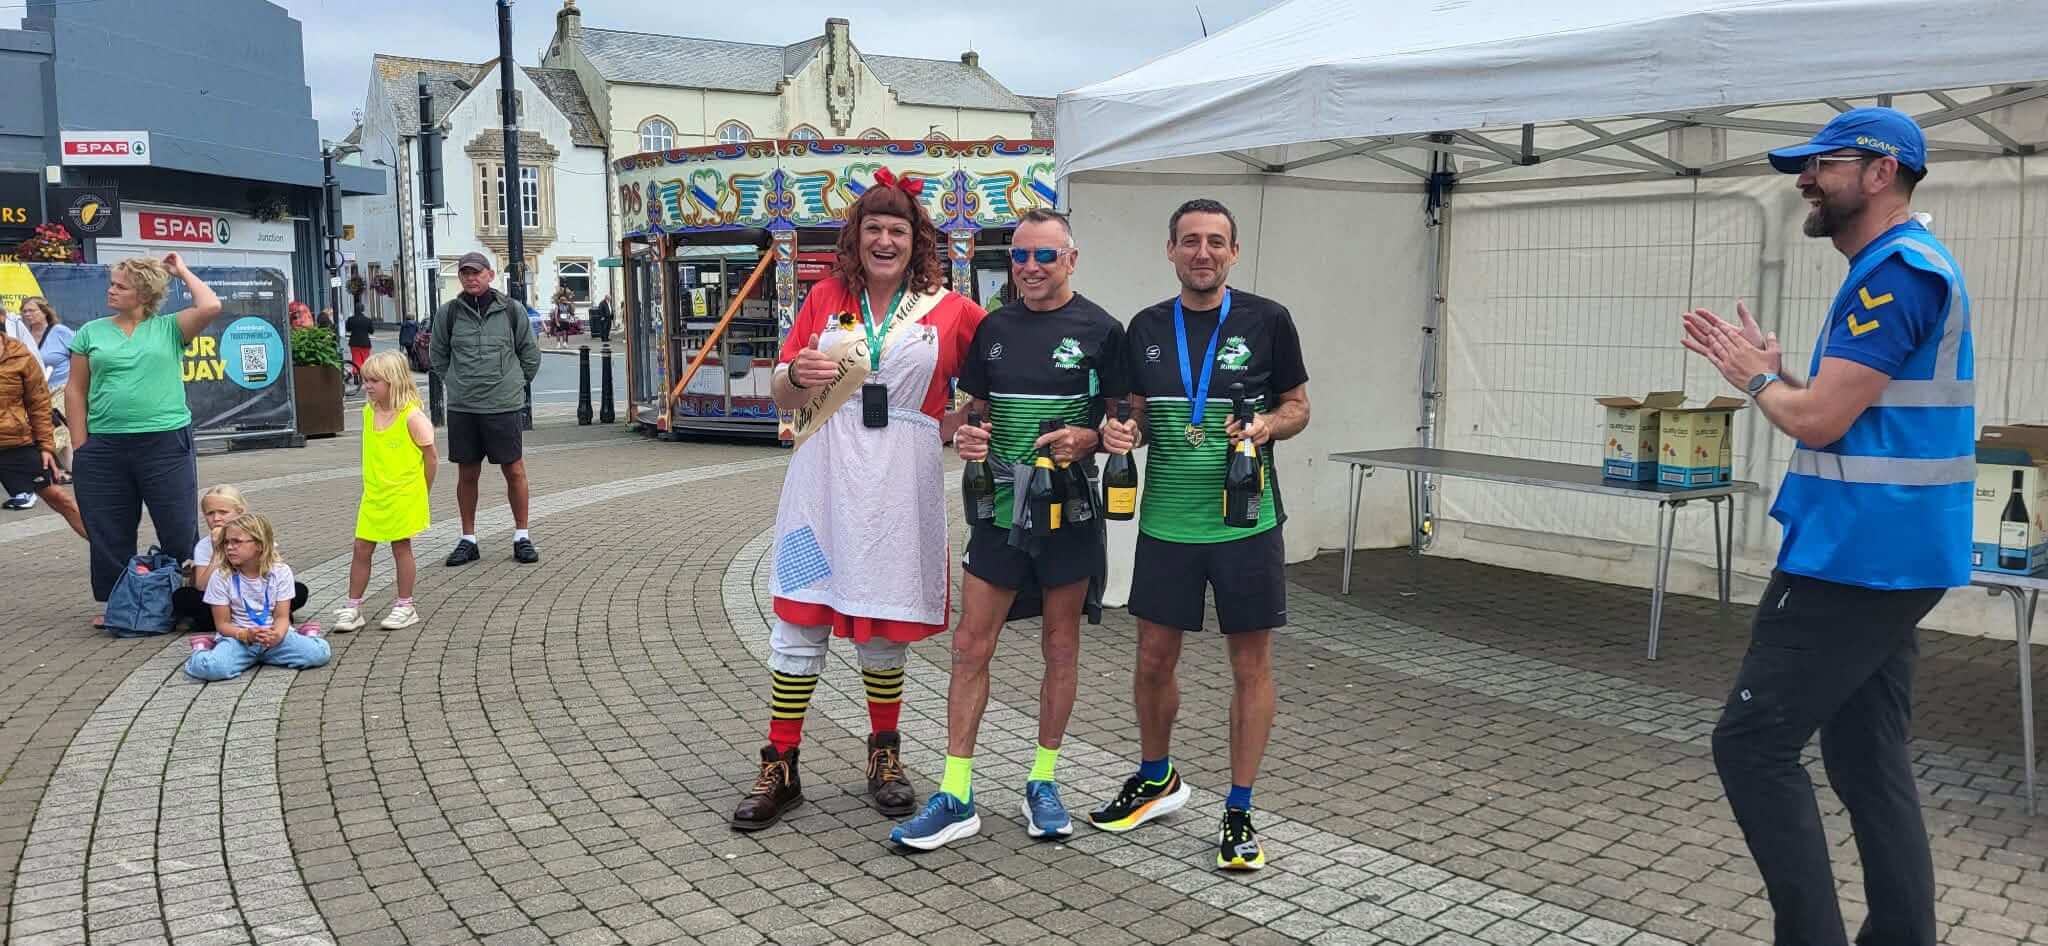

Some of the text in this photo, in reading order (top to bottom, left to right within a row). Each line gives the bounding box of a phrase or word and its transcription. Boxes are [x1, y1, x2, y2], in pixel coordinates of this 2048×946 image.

[76, 143, 128, 153] SPAR
[153, 218, 213, 240] SPAR
[256, 231, 284, 242] Junction
